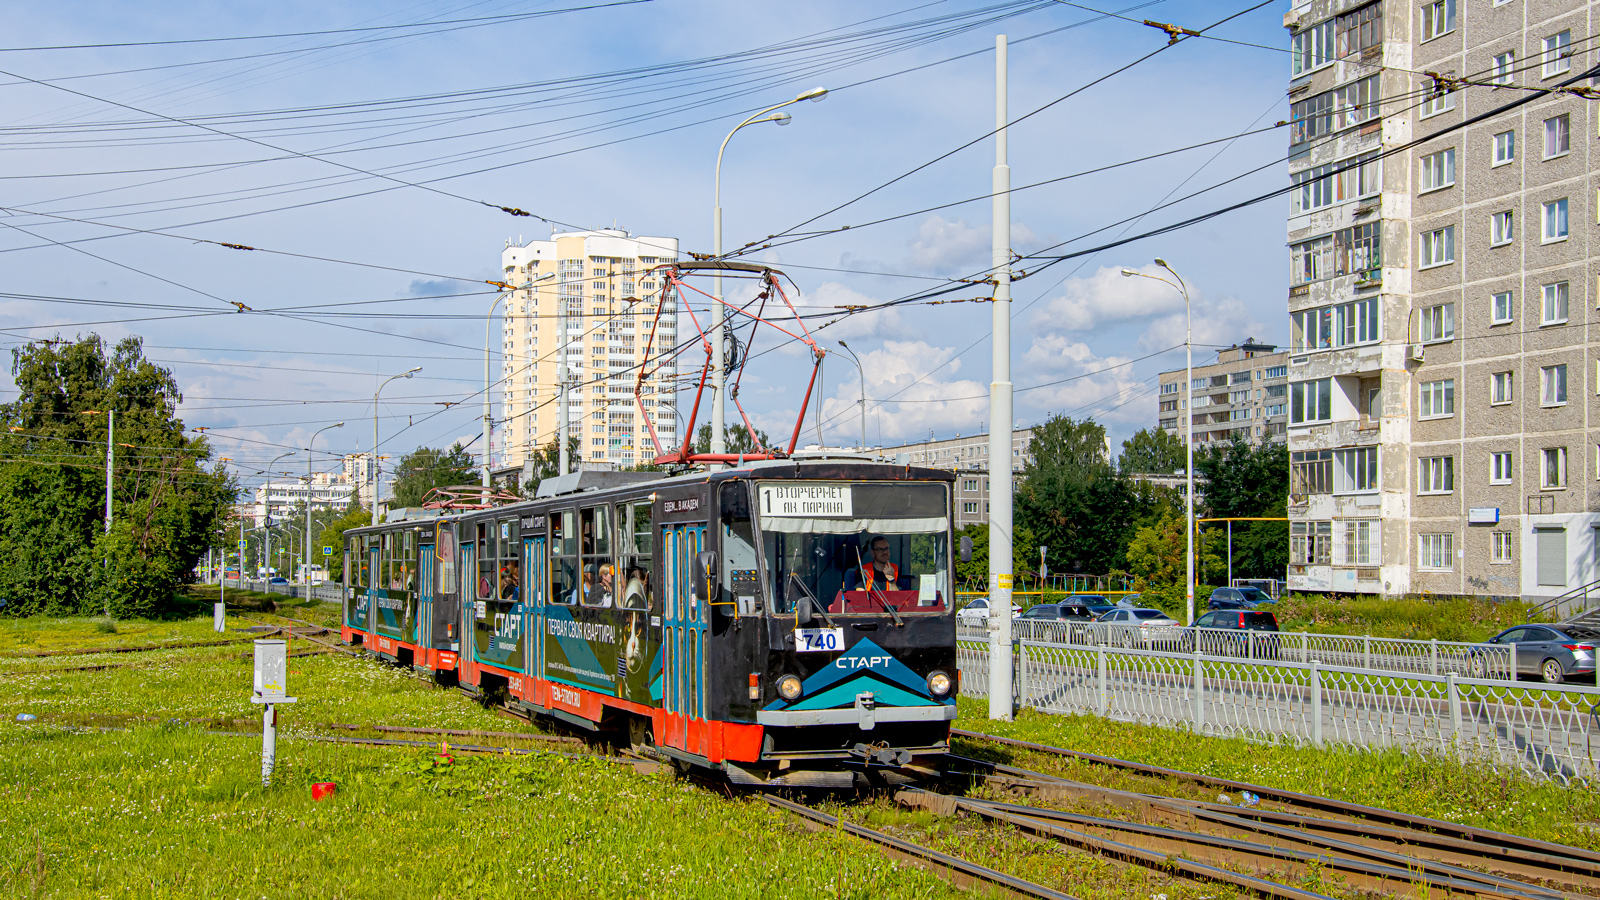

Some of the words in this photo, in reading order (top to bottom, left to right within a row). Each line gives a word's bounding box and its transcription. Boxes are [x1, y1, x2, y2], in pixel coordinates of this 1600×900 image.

[764, 489, 772, 513] 1
[776, 487, 842, 499] ВТОРЧЕРМЕТ
[682, 498, 699, 512] АКАДЕМ
[494, 612, 521, 640] СТАРТ
[547, 618, 567, 637] ПЕРВАЯ
[568, 620, 583, 640] СВОЯ
[583, 622, 616, 645] КВАРТИРА!
[803, 634, 836, 650] 740
[835, 656, 893, 669] СТАРТ
